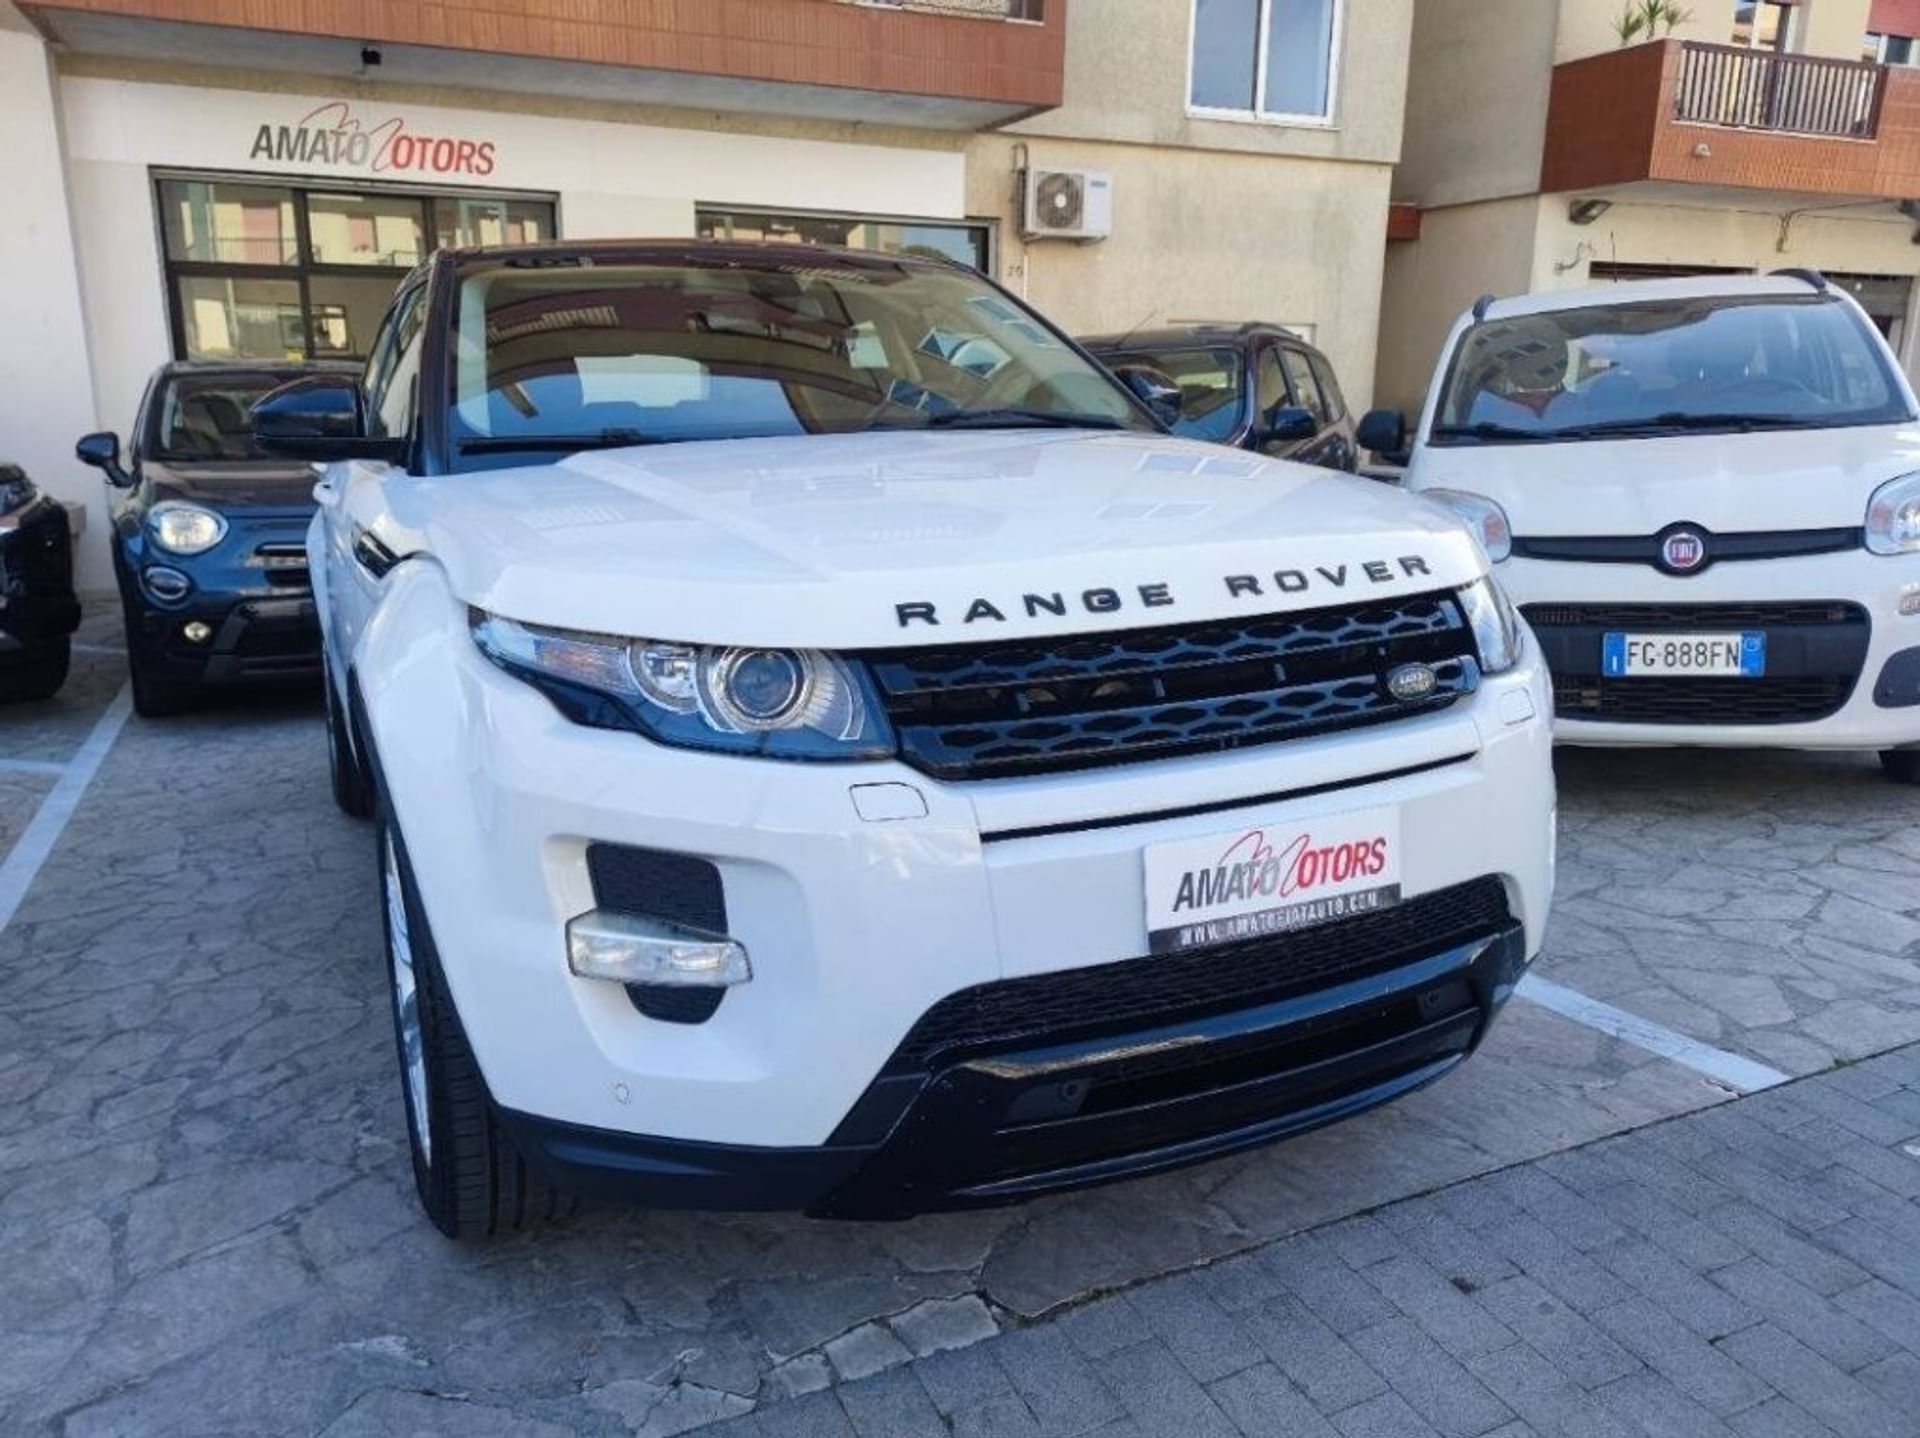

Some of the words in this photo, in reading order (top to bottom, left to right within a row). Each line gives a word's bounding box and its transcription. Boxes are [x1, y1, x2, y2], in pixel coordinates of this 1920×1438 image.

[250, 123, 370, 166] AMATO
[895, 582, 1175, 627] RANGE
[1224, 554, 1433, 598] ROVER
[1171, 856, 1281, 912] AMATO
